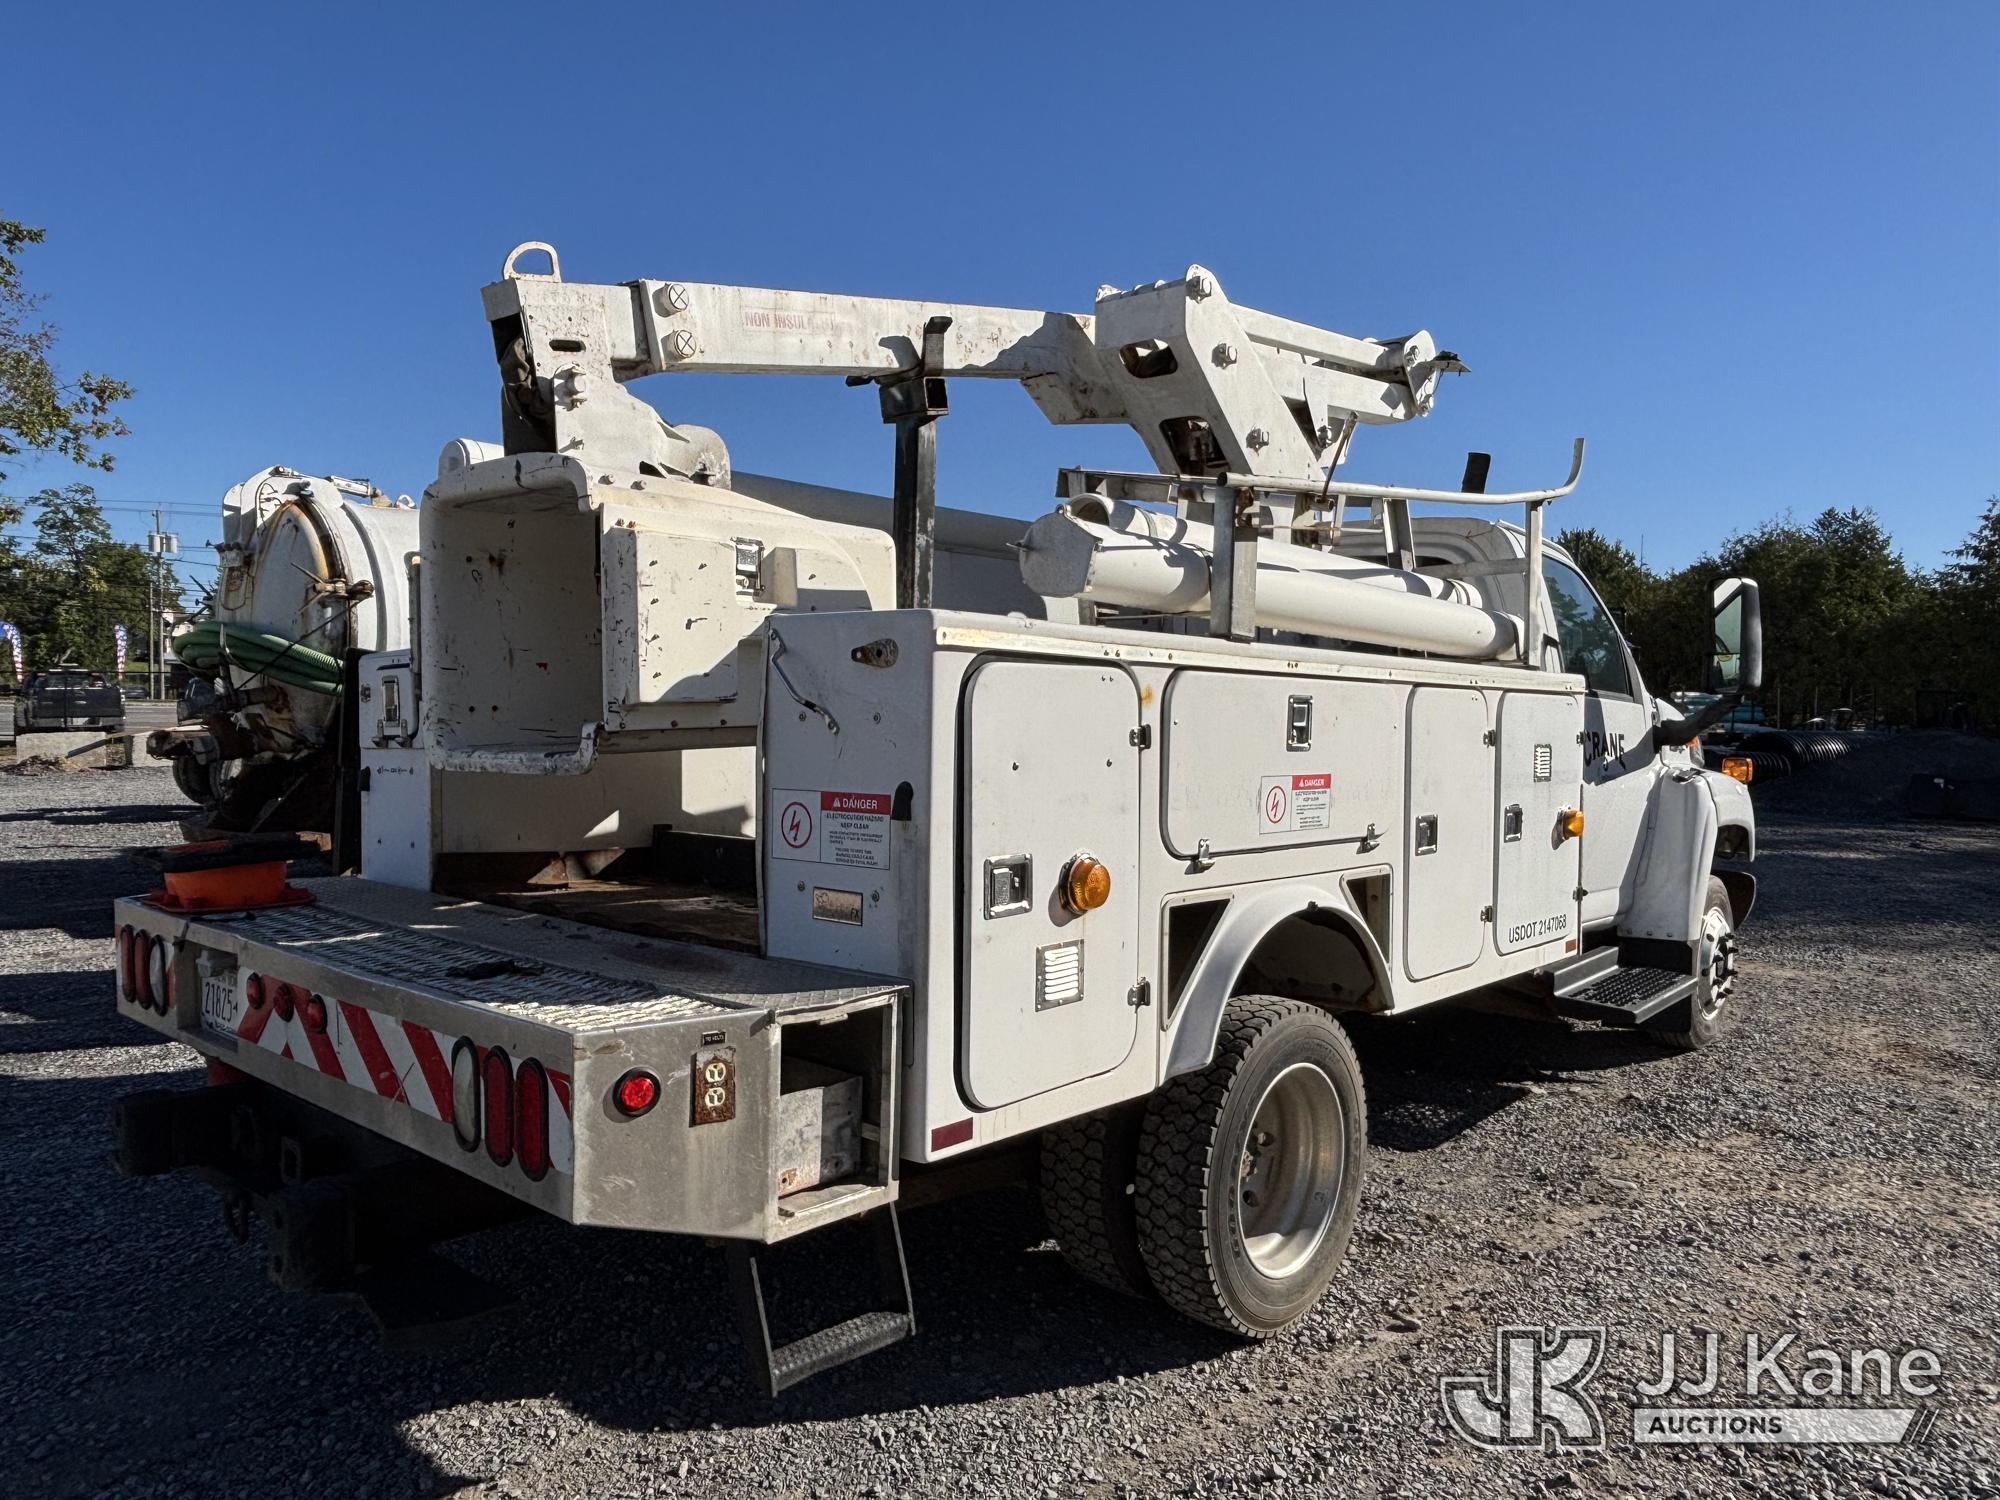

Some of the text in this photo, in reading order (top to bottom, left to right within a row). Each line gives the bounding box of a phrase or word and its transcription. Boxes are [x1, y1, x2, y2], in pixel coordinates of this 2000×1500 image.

[745, 312, 771, 328] NON
[842, 798, 878, 810] DANGER
[1508, 921, 1538, 944] USDOT
